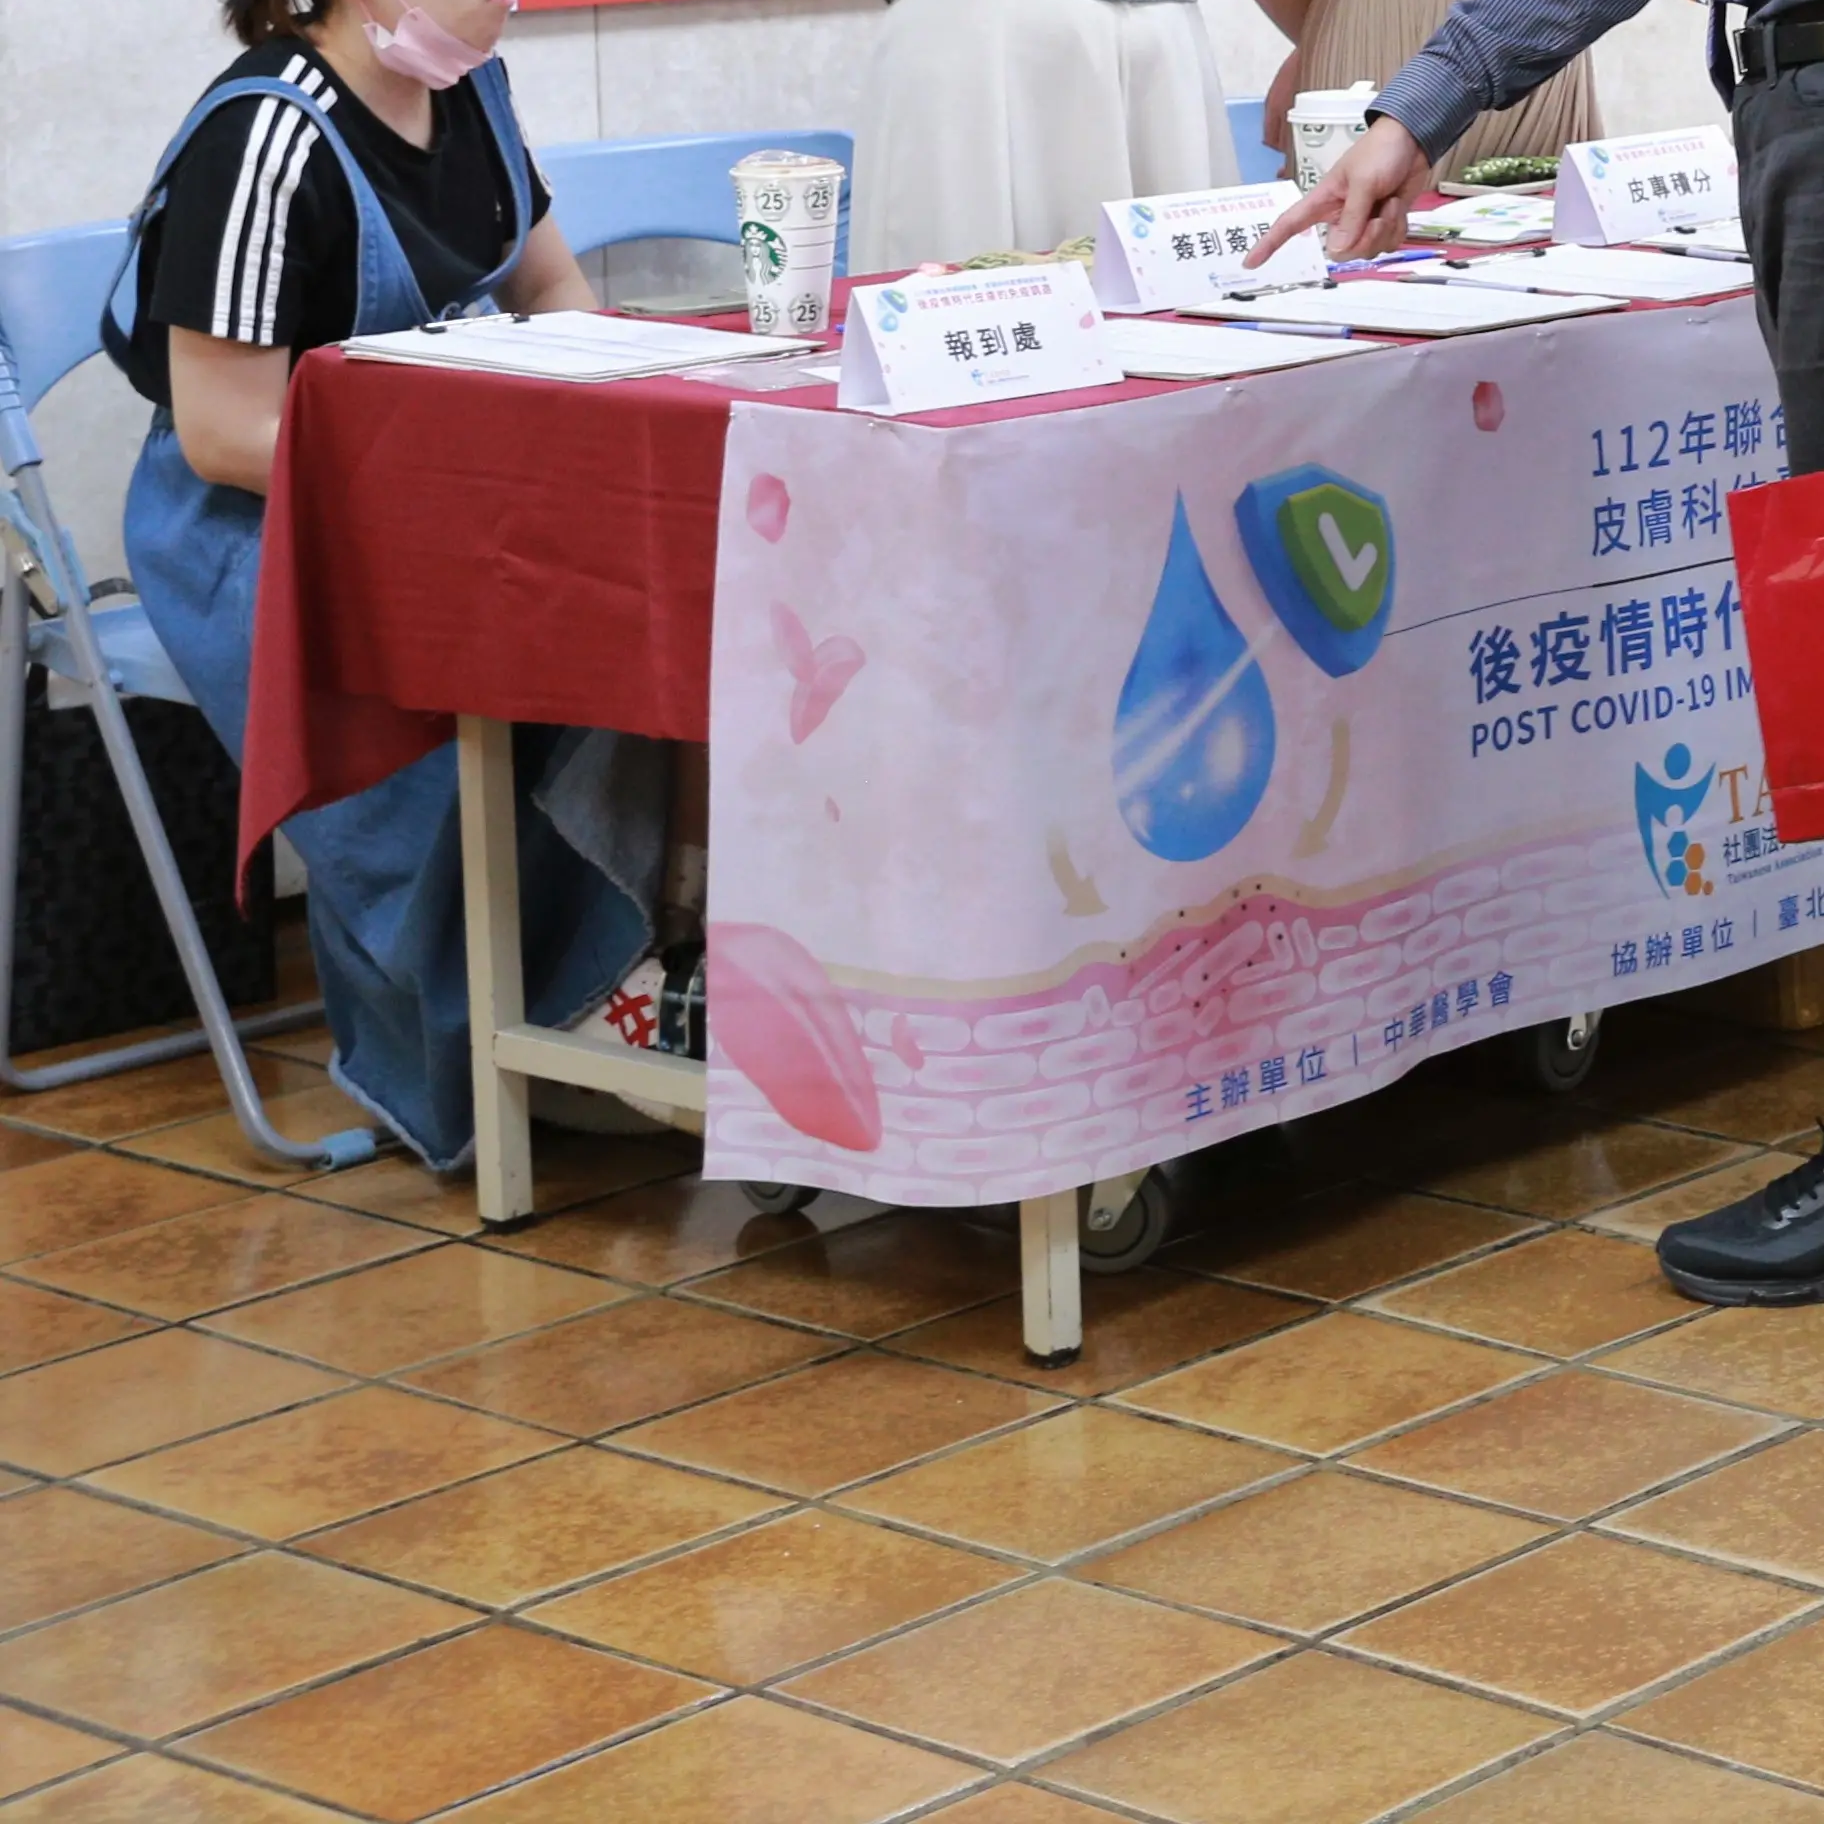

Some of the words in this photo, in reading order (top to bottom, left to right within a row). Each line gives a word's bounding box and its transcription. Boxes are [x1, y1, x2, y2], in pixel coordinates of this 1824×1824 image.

[762, 192, 784, 210] 25
[811, 191, 829, 208] 25
[755, 306, 773, 323] 25
[797, 304, 818, 323] 25
[944, 321, 1042, 362] 報到處
[1472, 704, 1558, 759] POST
[1571, 673, 1716, 735] COVID-19
[1722, 823, 1789, 868] 社團法
[1611, 917, 1734, 977] 協辦單位
[1185, 1044, 1328, 1122] 主辦單位
[1384, 970, 1514, 1052] 中華醫學會
